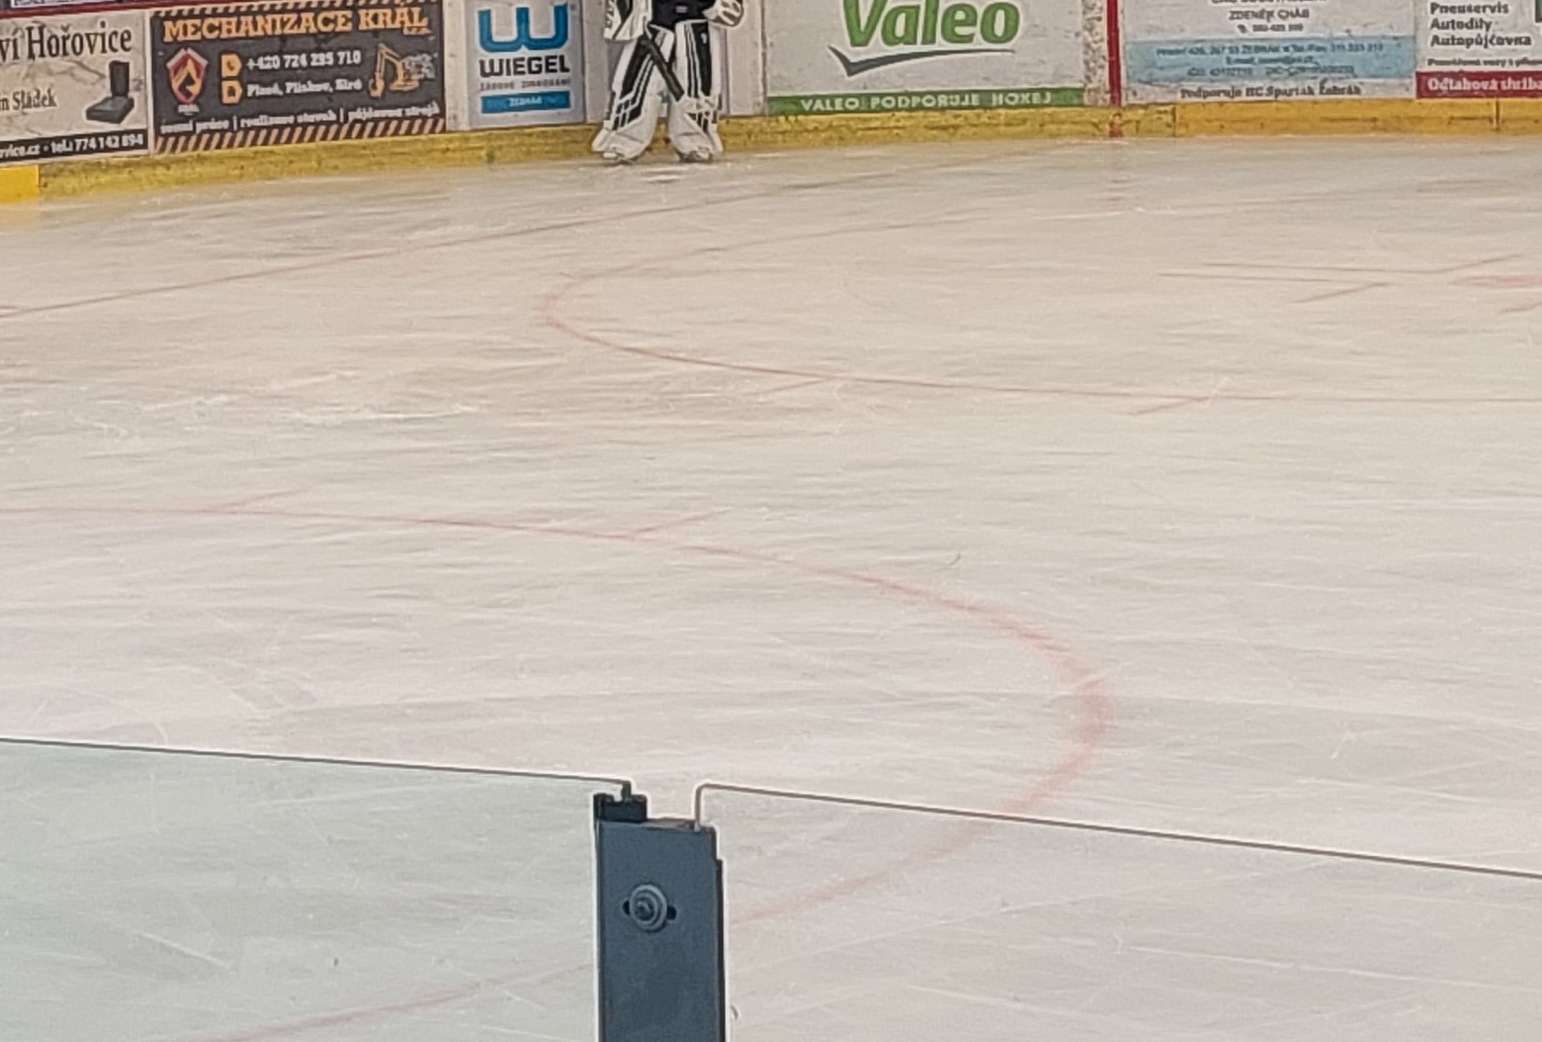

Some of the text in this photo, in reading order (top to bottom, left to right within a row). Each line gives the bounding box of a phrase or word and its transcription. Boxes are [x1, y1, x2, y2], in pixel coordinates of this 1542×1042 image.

[1430, 2, 1510, 15] Pneuservis
[163, 3, 428, 42] MECHANIZACE KRÁL
[1430, 18, 1492, 33] Autodíly
[26, 20, 132, 60] Hořovice
[1431, 33, 1532, 51] Autopůjčovna
[479, 55, 571, 78] WIEGEL
[12, 88, 57, 110] Sládek
[801, 90, 1051, 111] VALEO PODPORUJE HOKEJ
[75, 139, 96, 151] 774
